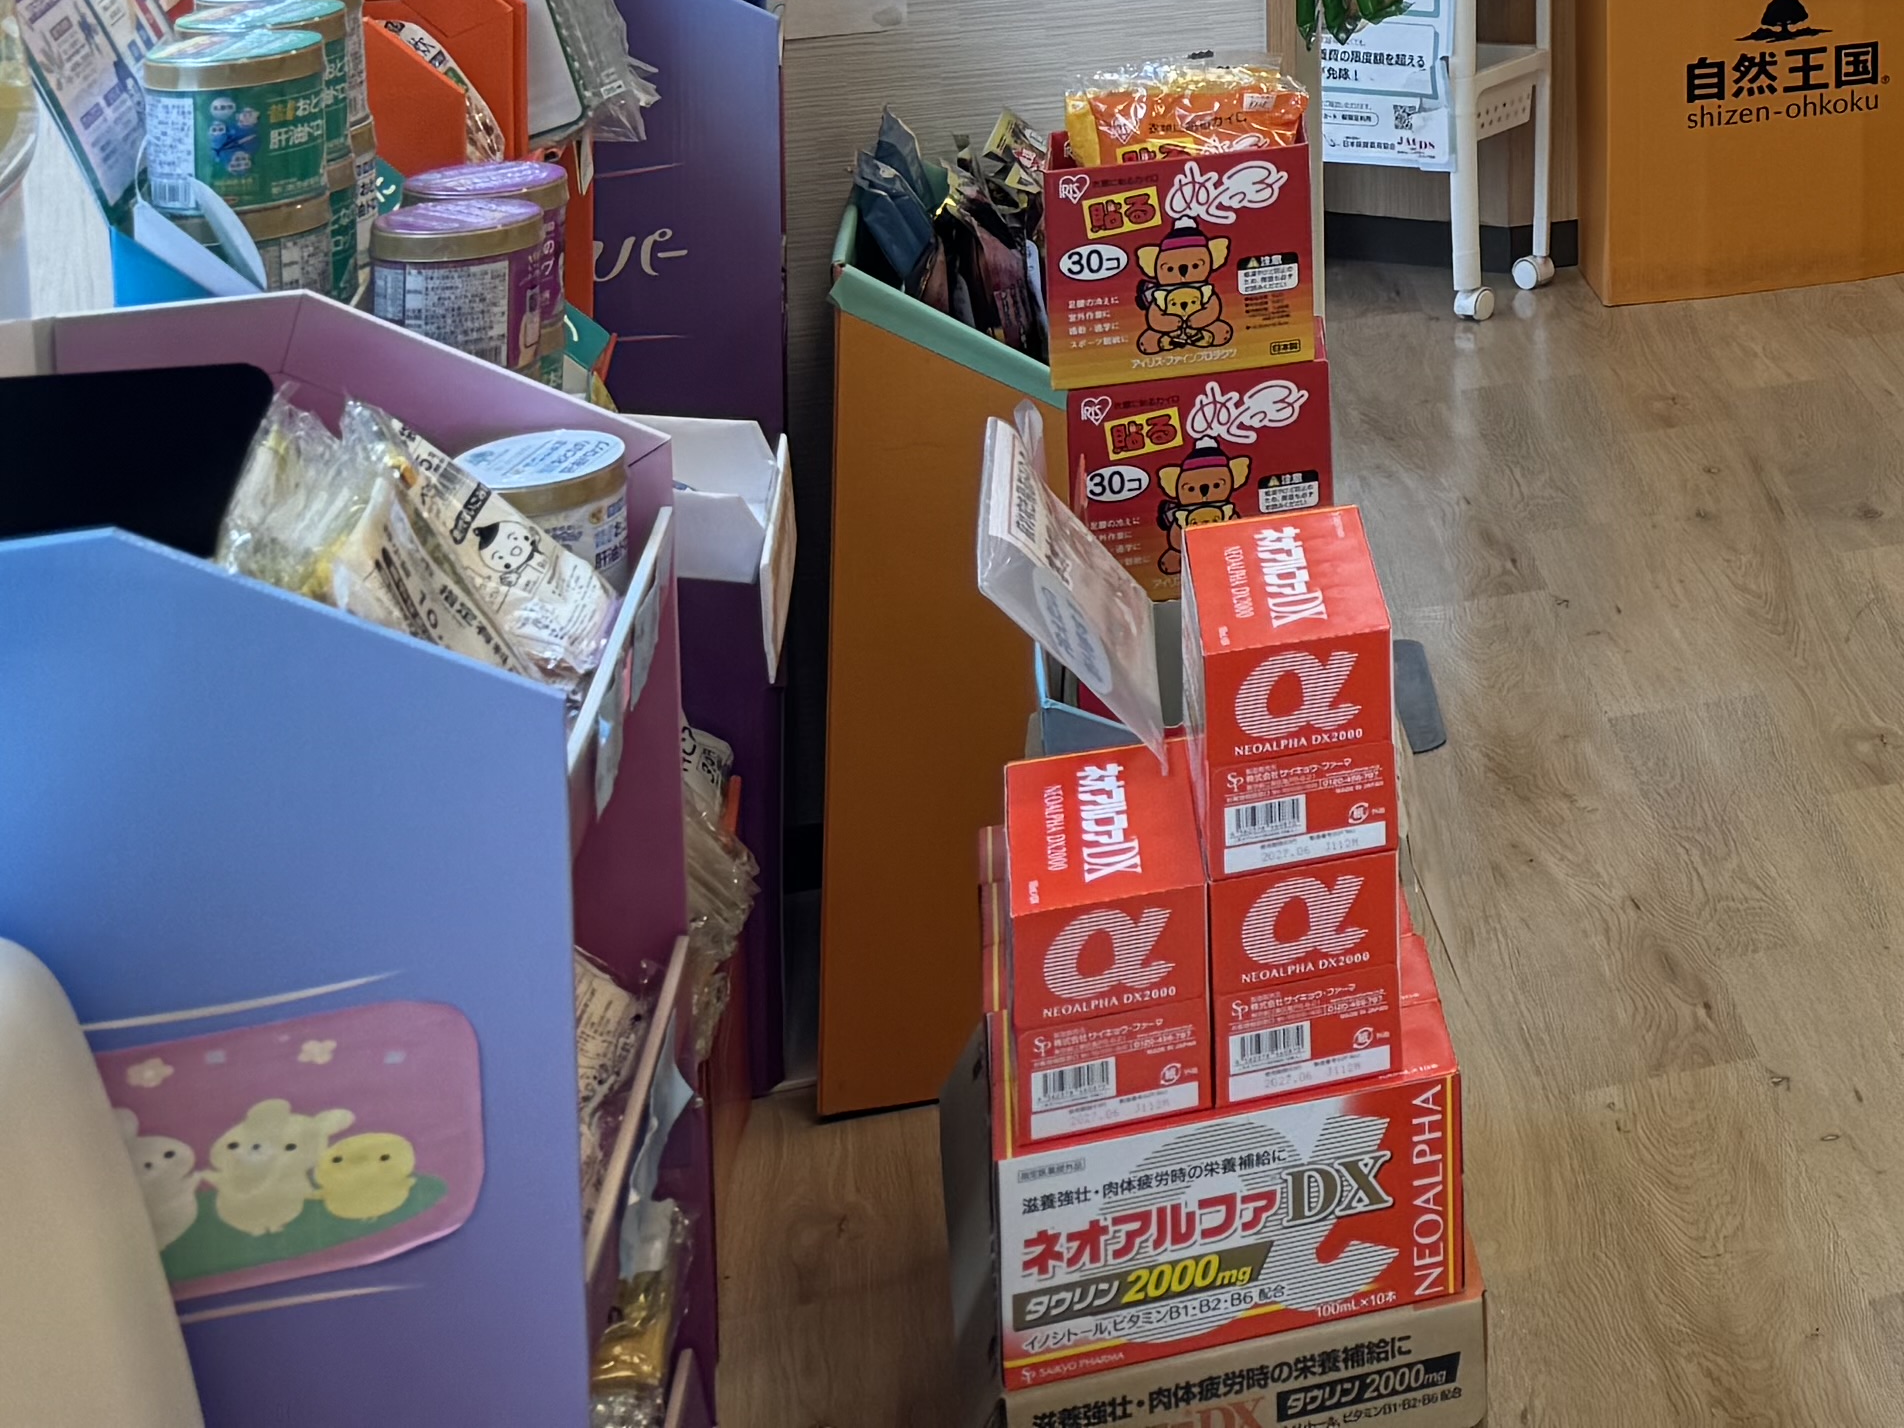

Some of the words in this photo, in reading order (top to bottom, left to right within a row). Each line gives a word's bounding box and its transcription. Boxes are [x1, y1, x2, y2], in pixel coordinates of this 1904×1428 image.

[1686, 41, 1879, 103] 自然王国
[1687, 90, 1879, 130] shizen-ohkoku
[1090, 192, 1157, 232] 貼る
[1067, 249, 1121, 275] 30コ
[1111, 414, 1177, 455] 貼る
[1089, 470, 1142, 495] 30コ
[1253, 524, 1328, 628] ネオアルファDX
[1234, 649, 1363, 740] α
[1234, 737, 1308, 757] NEOALPHA
[1311, 728, 1364, 748] DX2000
[1075, 762, 1143, 883] ネオアルファDX
[1241, 874, 1369, 966] α
[1042, 906, 1176, 1000] α
[1241, 961, 1316, 984] NEOALPHA
[1318, 951, 1370, 970] DX2000
[1042, 996, 1120, 1020] NEOALPHA
[1123, 985, 1177, 1004] DX2000
[1021, 1148, 1288, 1215] 滋養強壮・肉体疲労時の栄養補給に
[1414, 1083, 1444, 1296] NEOALPHA
[1021, 1187, 1279, 1276] ネオアルファ
[1283, 1150, 1394, 1226] DX
[1026, 1282, 1119, 1322] タウリン
[1126, 1253, 1252, 1302] 2000mg
[1258, 1284, 1286, 1301] 配合
[1315, 1290, 1397, 1318] 100mL×10本
[1032, 1334, 1413, 1428] 滋養強壮・肉体疲労時の栄養補給に
[1286, 1381, 1359, 1418] タウリン
[1365, 1363, 1447, 1402] 2000mg
[1440, 1387, 1463, 1402] 配合
